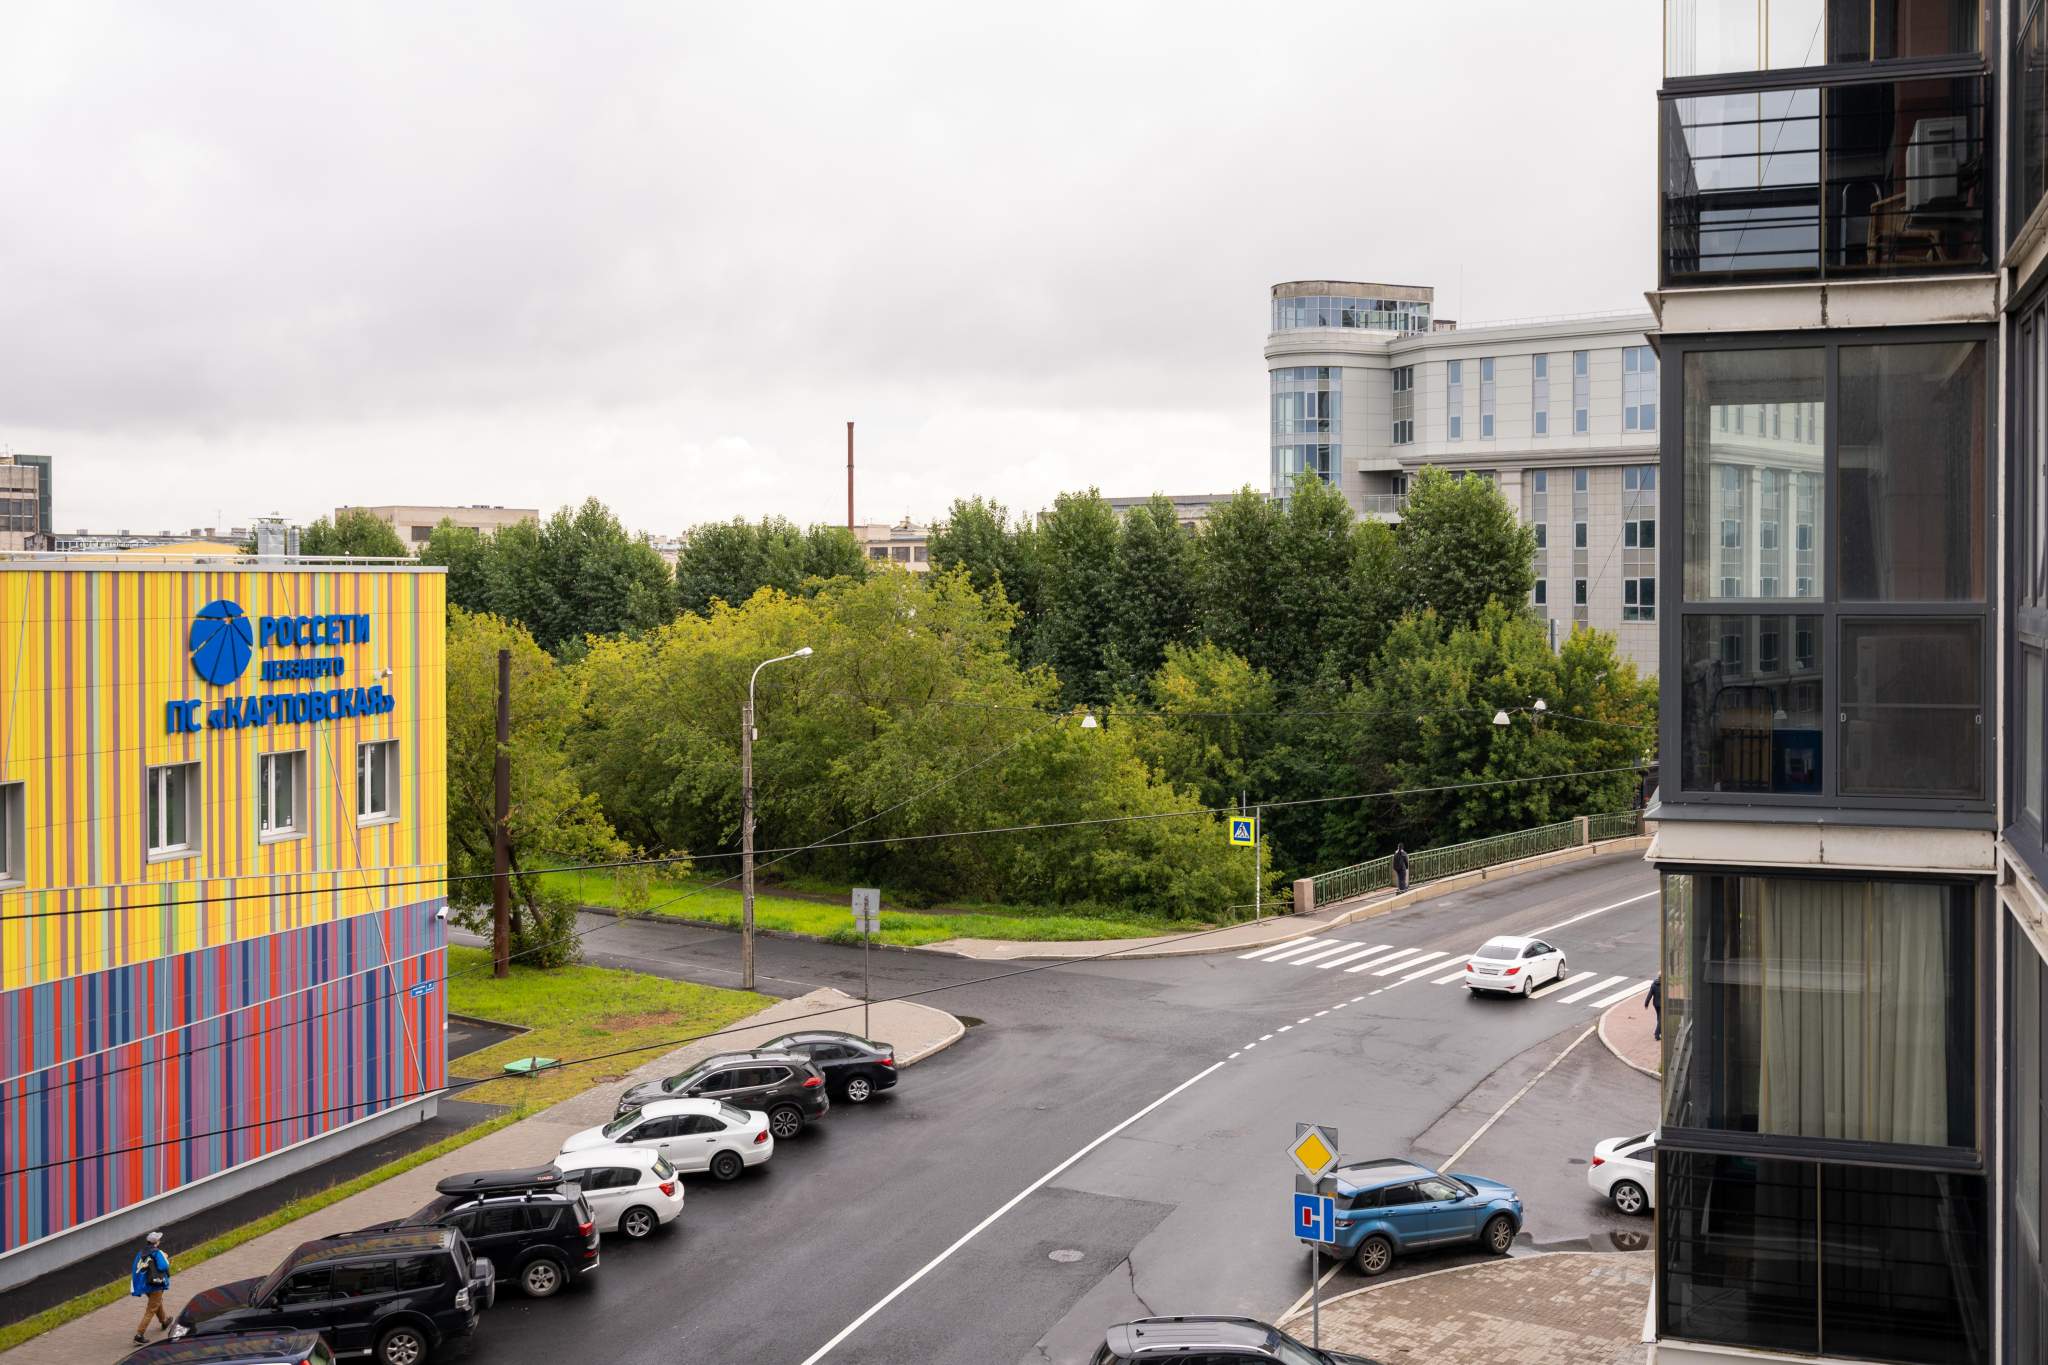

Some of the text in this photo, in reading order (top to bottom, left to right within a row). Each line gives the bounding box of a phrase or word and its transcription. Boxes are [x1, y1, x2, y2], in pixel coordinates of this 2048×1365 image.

[260, 614, 370, 648] РОССЕТИ
[261, 656, 345, 681] ЛЕНЭНЕРГО
[166, 685, 395, 734] ПС «КАРПОВСКАЯ»
